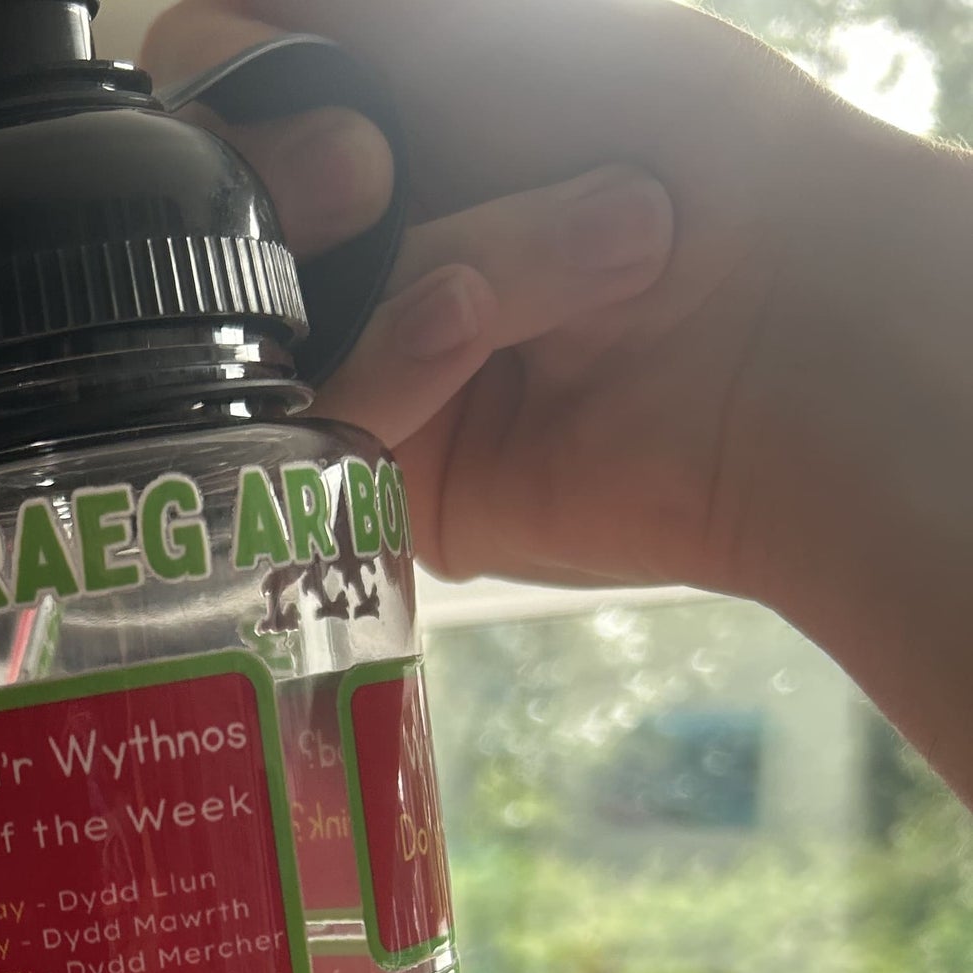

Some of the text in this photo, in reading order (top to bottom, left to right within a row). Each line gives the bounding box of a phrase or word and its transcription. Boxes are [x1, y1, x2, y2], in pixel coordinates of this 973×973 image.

[232, 459, 339, 571] AR
[48, 719, 247, 779] Wythnos
[32, 814, 108, 849] the
[127, 786, 252, 834] Week
[58, 880, 139, 913] Dydd
[151, 870, 216, 899] Llun
[43, 918, 121, 952] Dydd
[134, 899, 249, 937] Mawrth
[159, 930, 284, 968] Mercher
